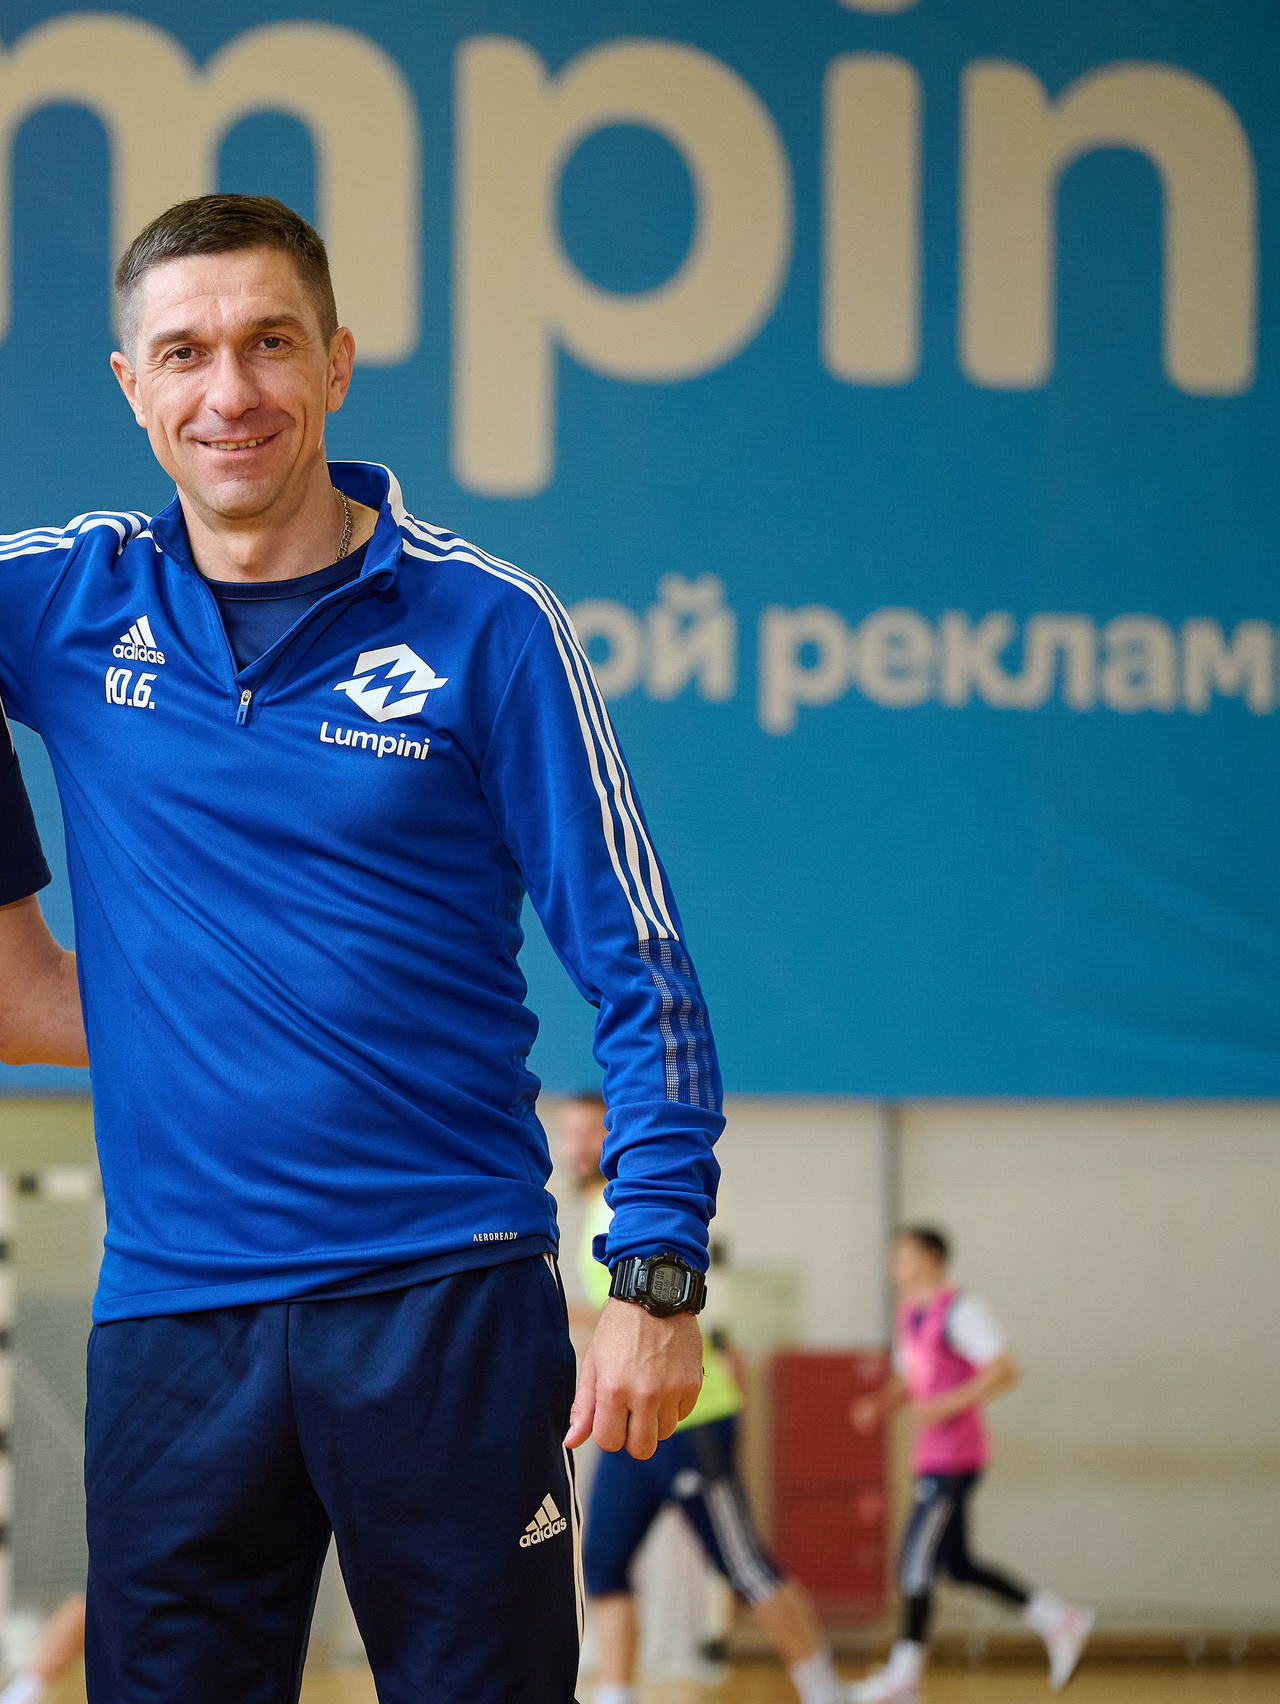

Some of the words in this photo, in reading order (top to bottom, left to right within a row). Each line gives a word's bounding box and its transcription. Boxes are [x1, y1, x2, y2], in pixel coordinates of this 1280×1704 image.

[112, 642, 166, 665] adidas
[758, 604, 1280, 736] реклам
[320, 720, 431, 761] Lumpini
[472, 1231, 518, 1242] AEROREADY
[519, 1517, 568, 1548] adidas
